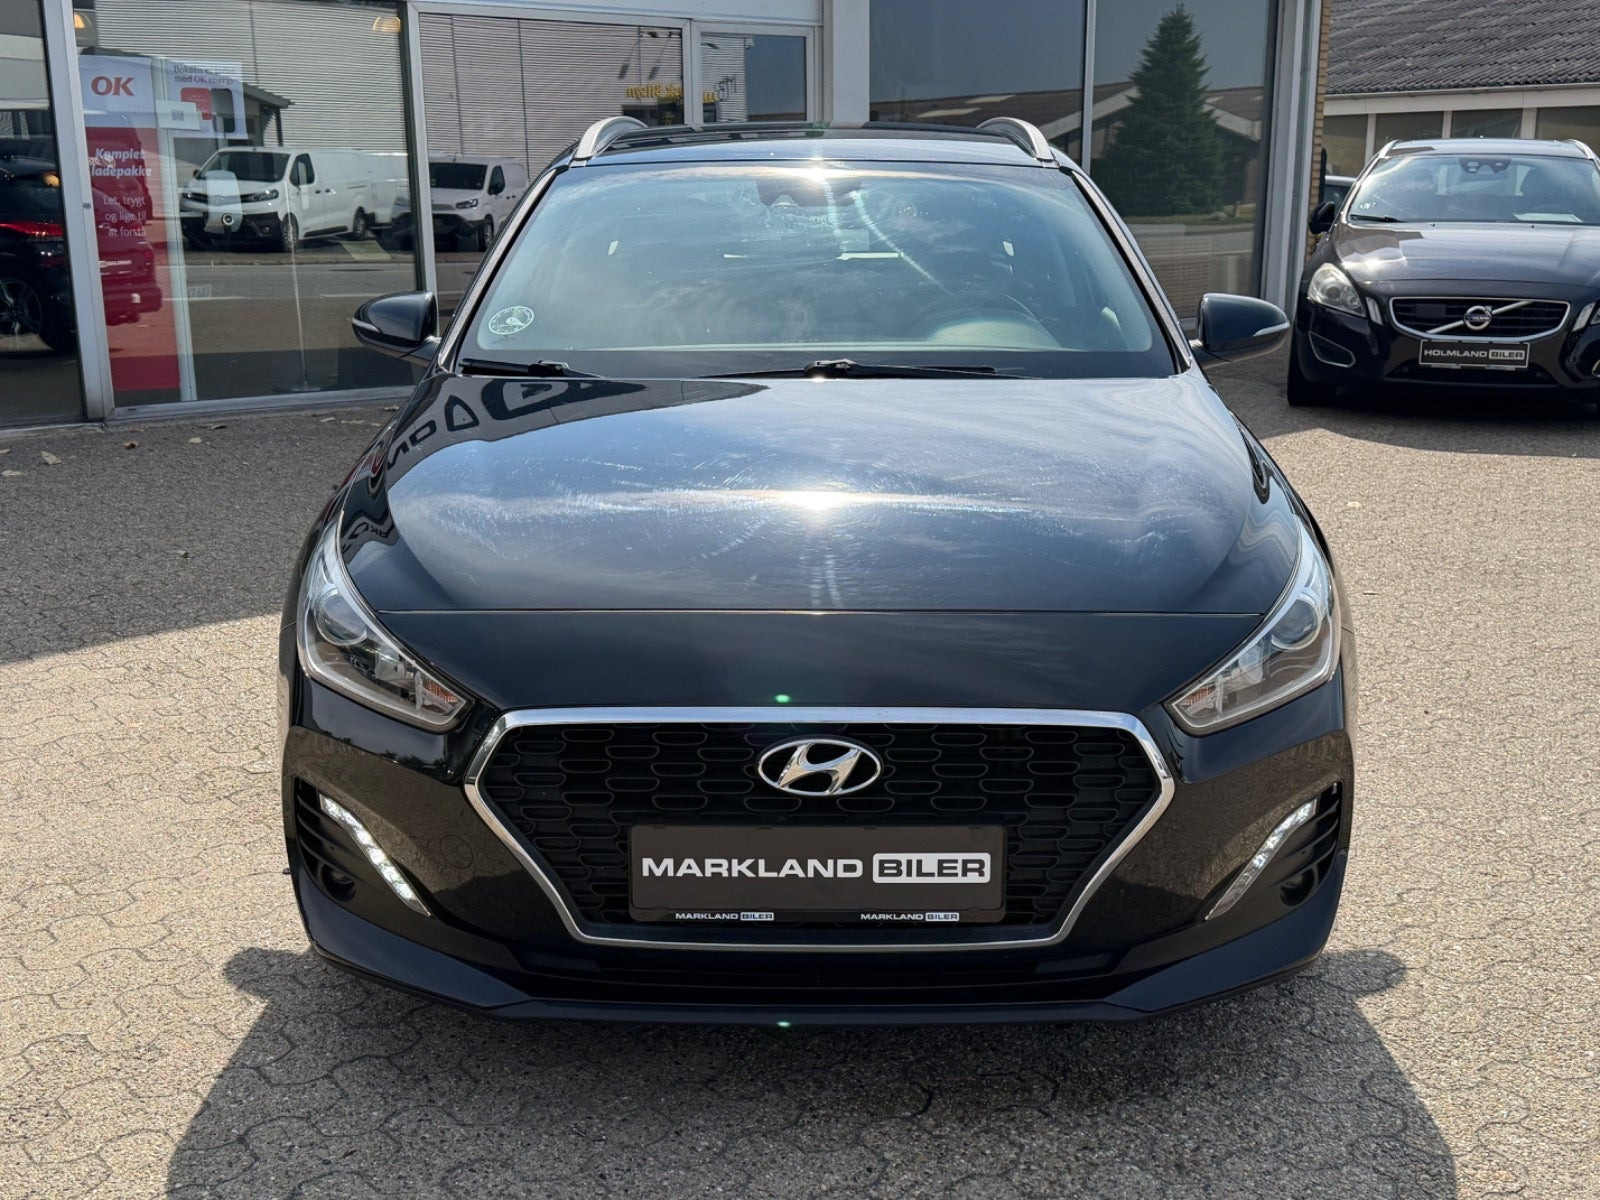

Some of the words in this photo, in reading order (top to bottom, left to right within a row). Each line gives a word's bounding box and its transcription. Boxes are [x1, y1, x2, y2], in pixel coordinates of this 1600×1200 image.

[174, 75, 192, 83] med
[91, 76, 135, 97] OK
[95, 148, 146, 163] Komplet
[91, 164, 152, 179] ladepakke
[105, 213, 118, 223] og
[1424, 349, 1487, 358] HOLMLAND
[1491, 350, 1524, 359] BILER
[642, 857, 864, 879] MARKLAND
[878, 858, 986, 878] BILER
[675, 912, 739, 920] MARKLAND
[742, 912, 773, 920] BILER
[926, 913, 958, 921] BILER
